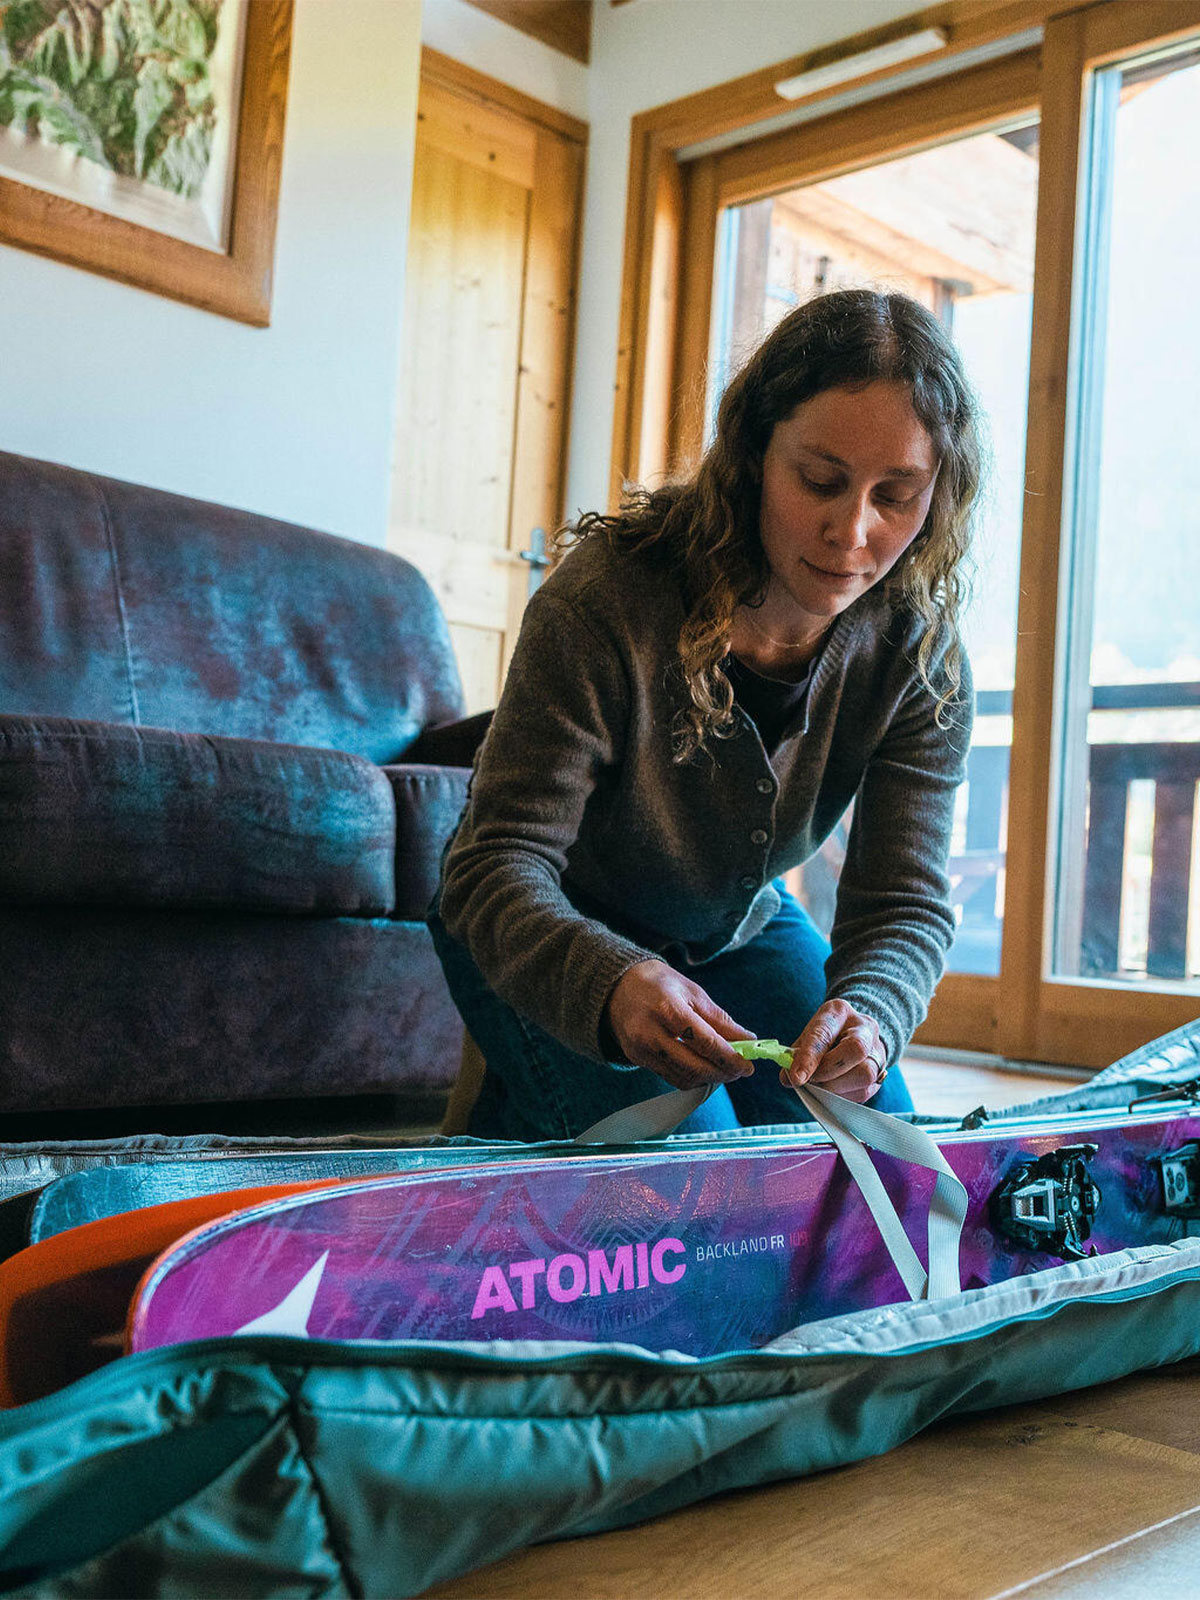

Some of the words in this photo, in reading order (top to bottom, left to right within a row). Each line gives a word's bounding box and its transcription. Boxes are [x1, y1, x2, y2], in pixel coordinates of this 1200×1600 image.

[696, 1236, 768, 1262] BACKLAND
[770, 1234, 785, 1250] FR
[471, 1237, 687, 1320] ATOMIC
